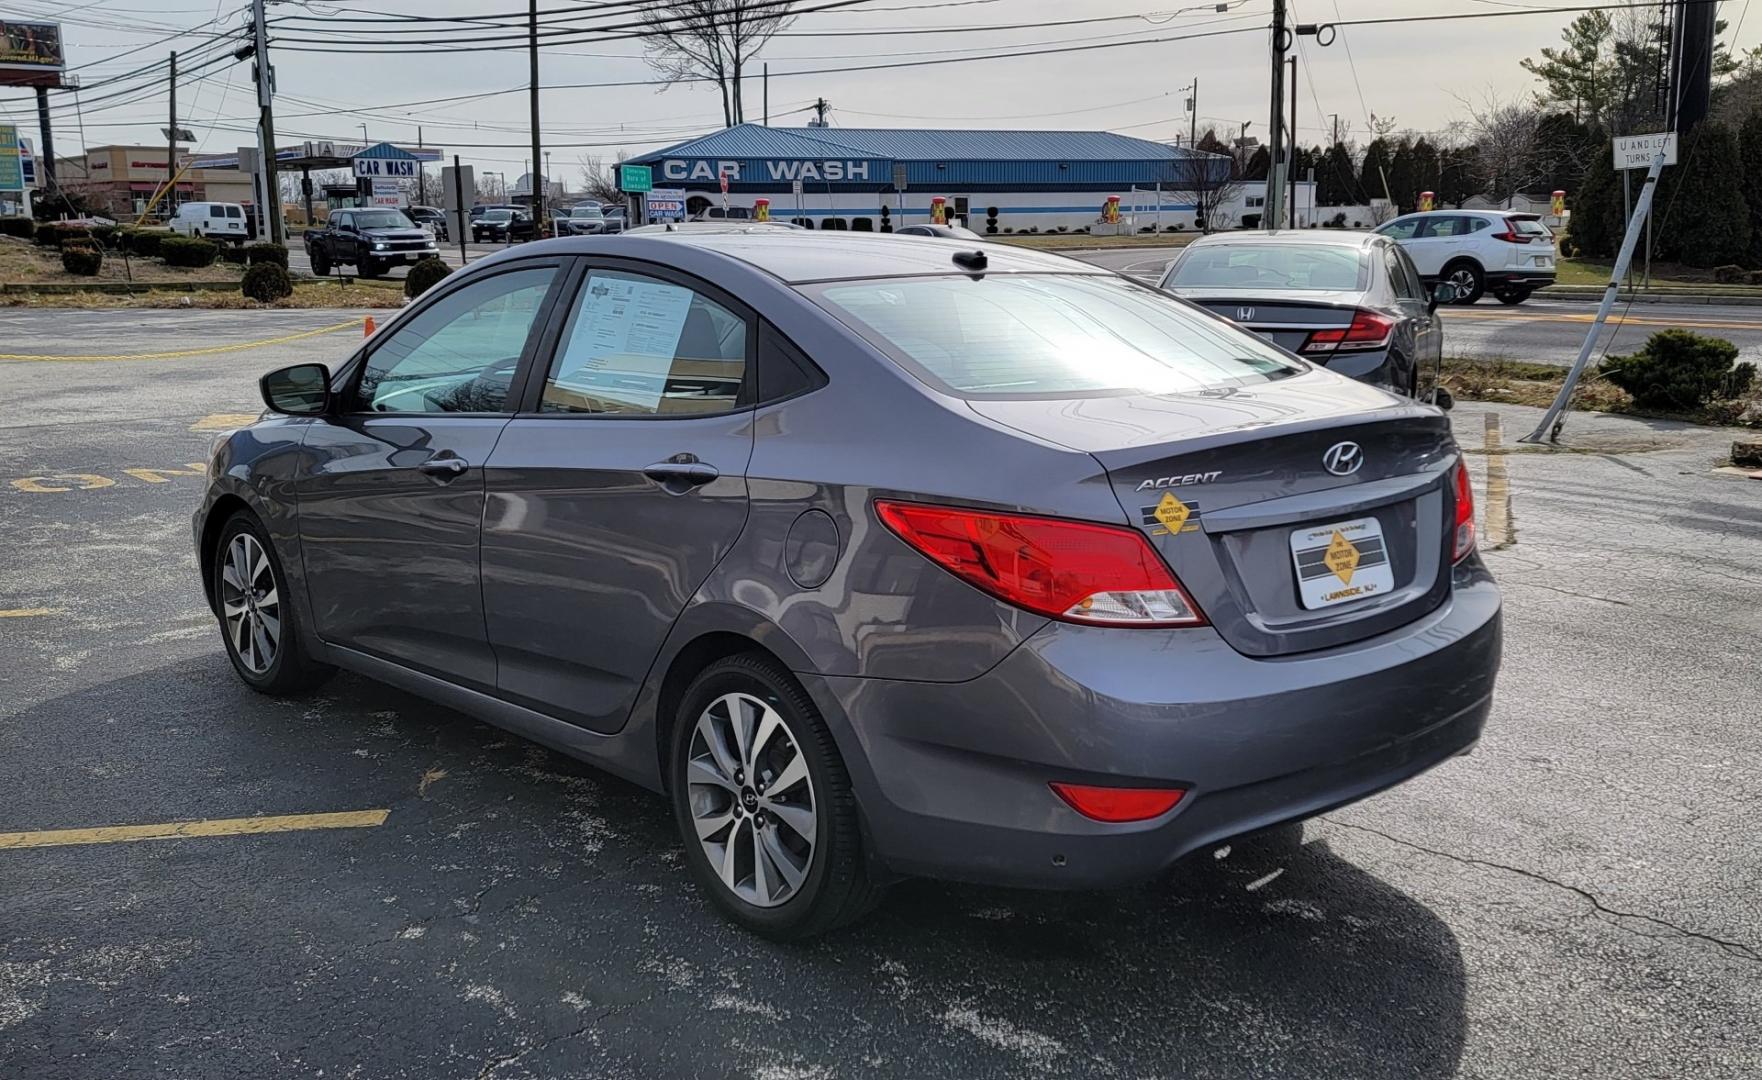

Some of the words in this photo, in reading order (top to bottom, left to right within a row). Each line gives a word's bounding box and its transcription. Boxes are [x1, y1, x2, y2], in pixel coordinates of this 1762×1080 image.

[1620, 141, 1627, 151] U
[1631, 140, 1649, 150] AND
[1625, 152, 1651, 163] TURNS
[359, 160, 380, 176] CAR
[385, 160, 414, 176] WASH
[664, 160, 742, 180] CAR
[766, 160, 869, 180] WASH
[650, 201, 677, 209] OPEN
[649, 210, 664, 218] CAR
[665, 210, 684, 218] WASH
[1135, 470, 1223, 493] ACCENT
[1159, 506, 1183, 515] MOTOR
[1165, 514, 1182, 523] ZONE
[1329, 548, 1354, 560] MOTOR
[1335, 560, 1352, 572] ZONE
